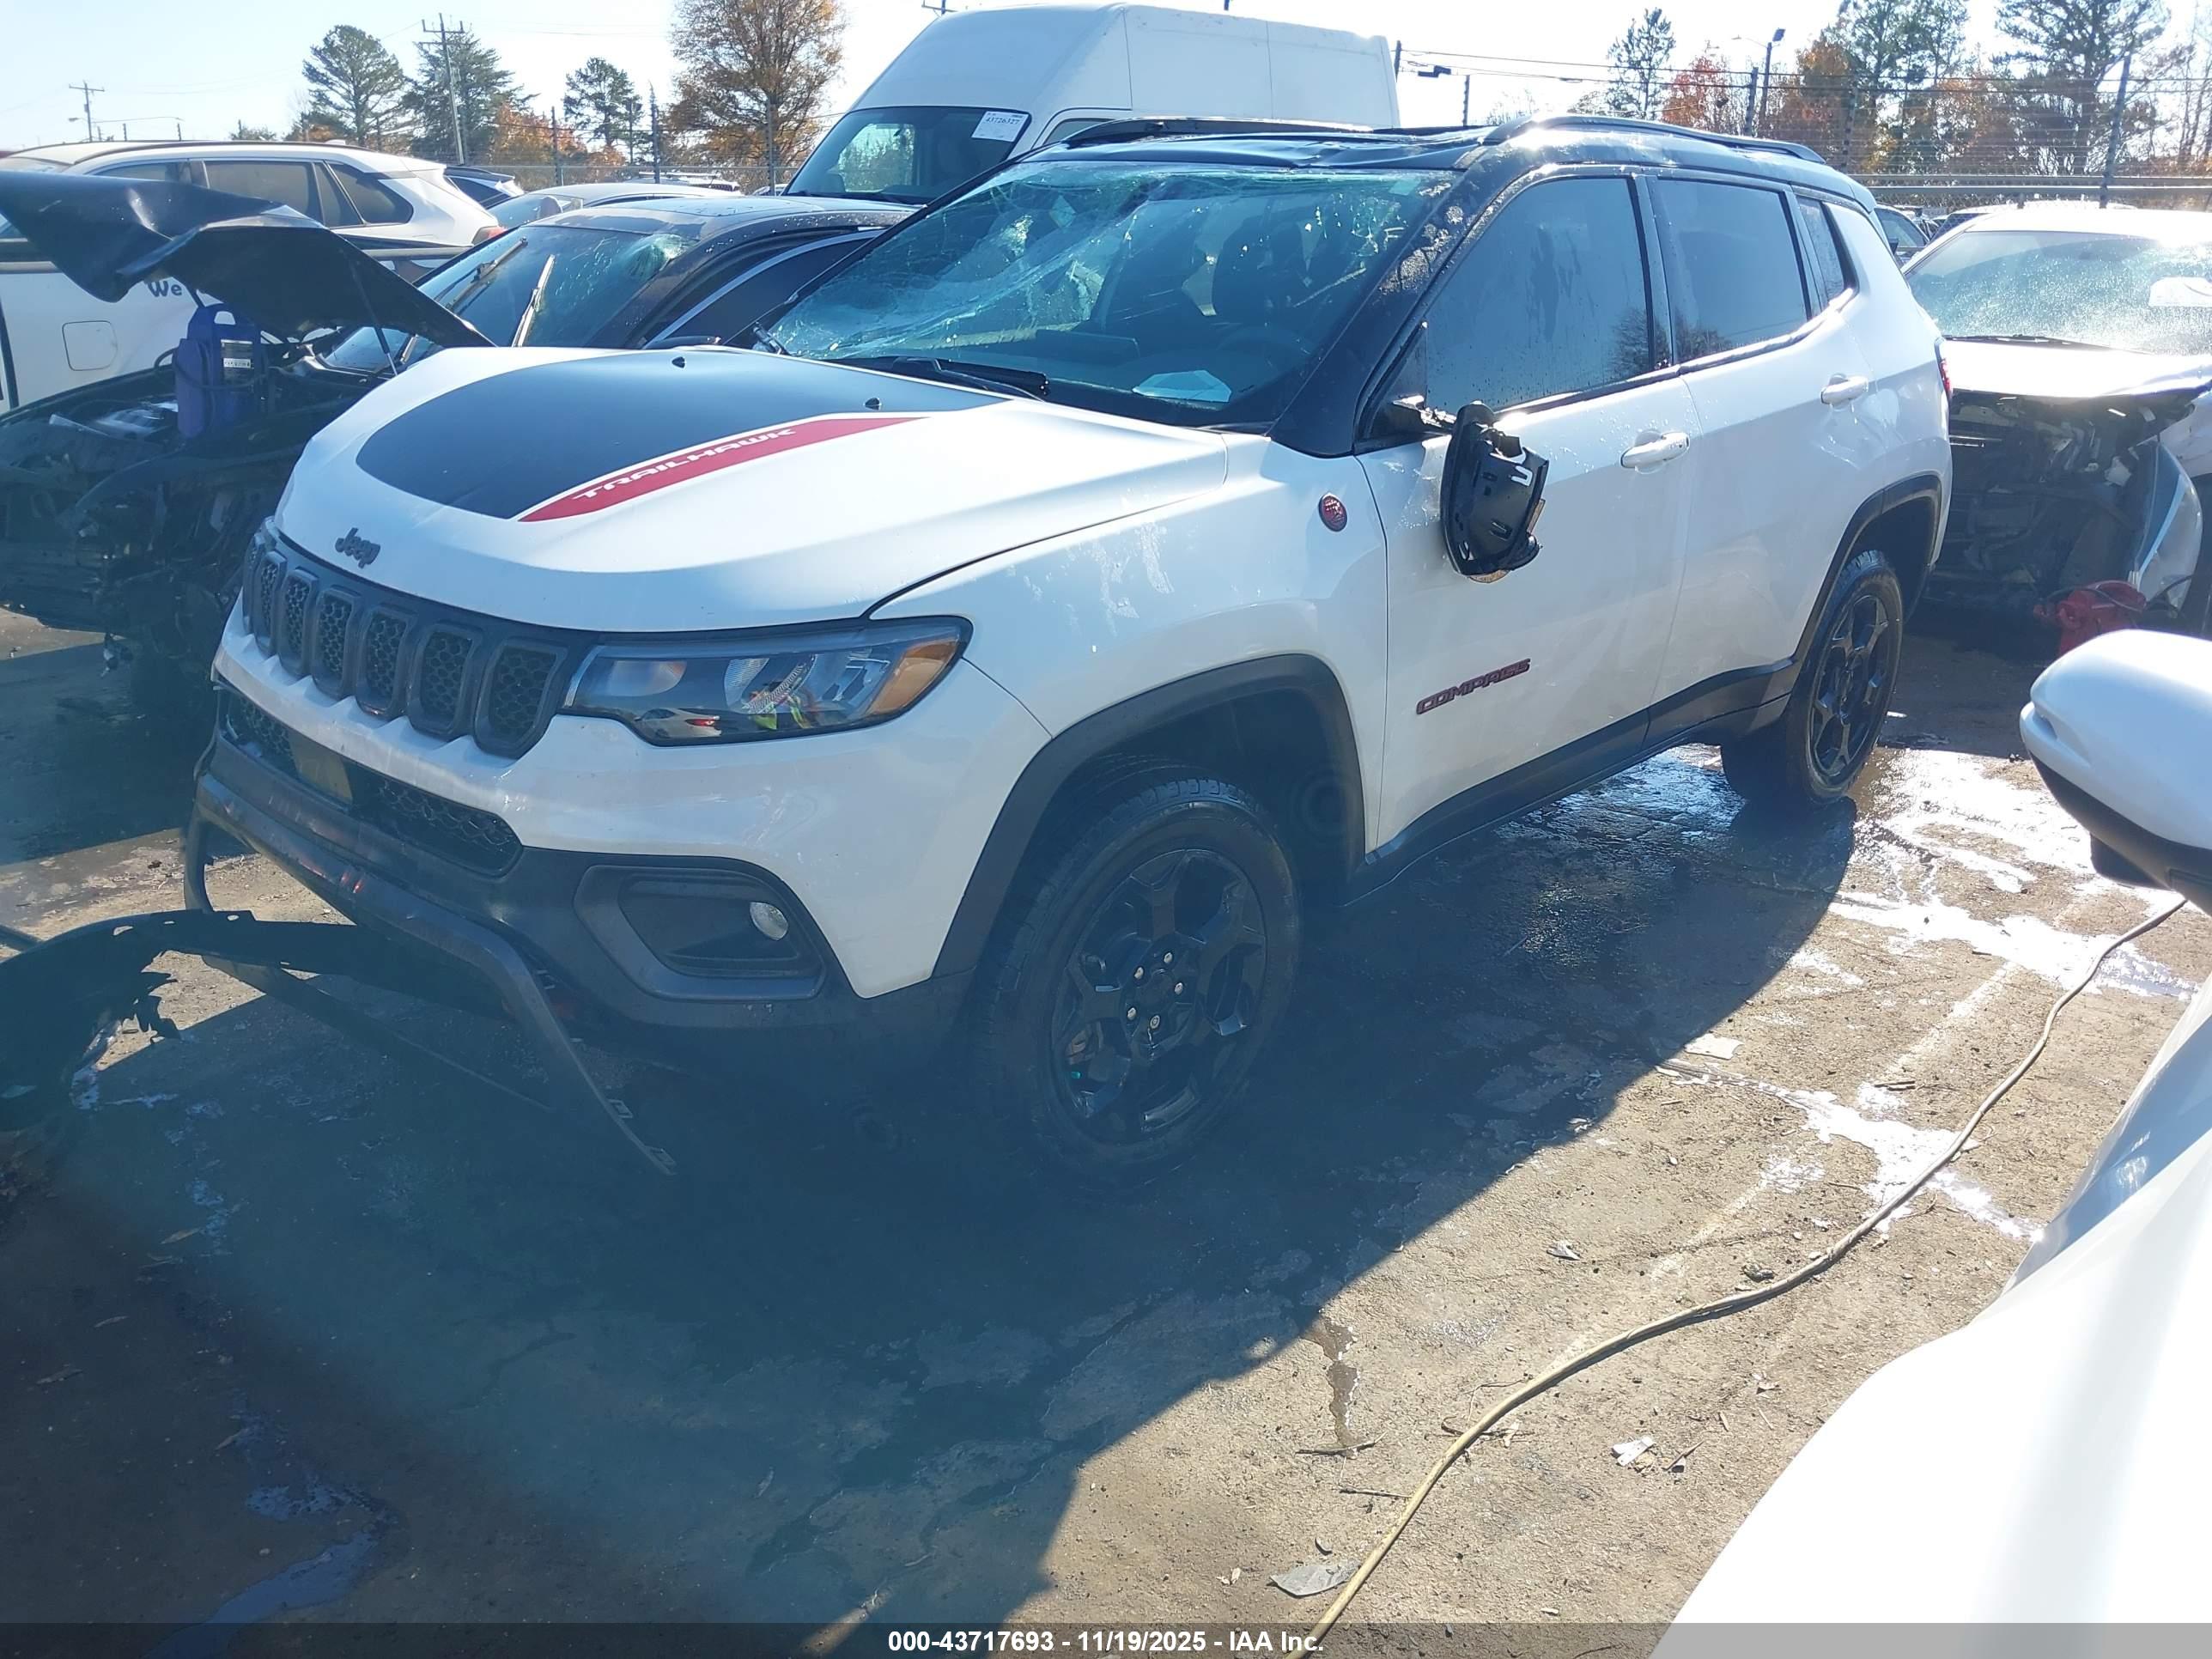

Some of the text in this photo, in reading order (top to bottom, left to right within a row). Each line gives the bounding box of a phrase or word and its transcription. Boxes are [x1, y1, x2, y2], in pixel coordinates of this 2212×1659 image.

[148, 280, 182, 297] We
[573, 428, 796, 500] TRAILHAWK
[335, 527, 380, 568] Jeep
[1416, 658, 1531, 714] COMPASS
